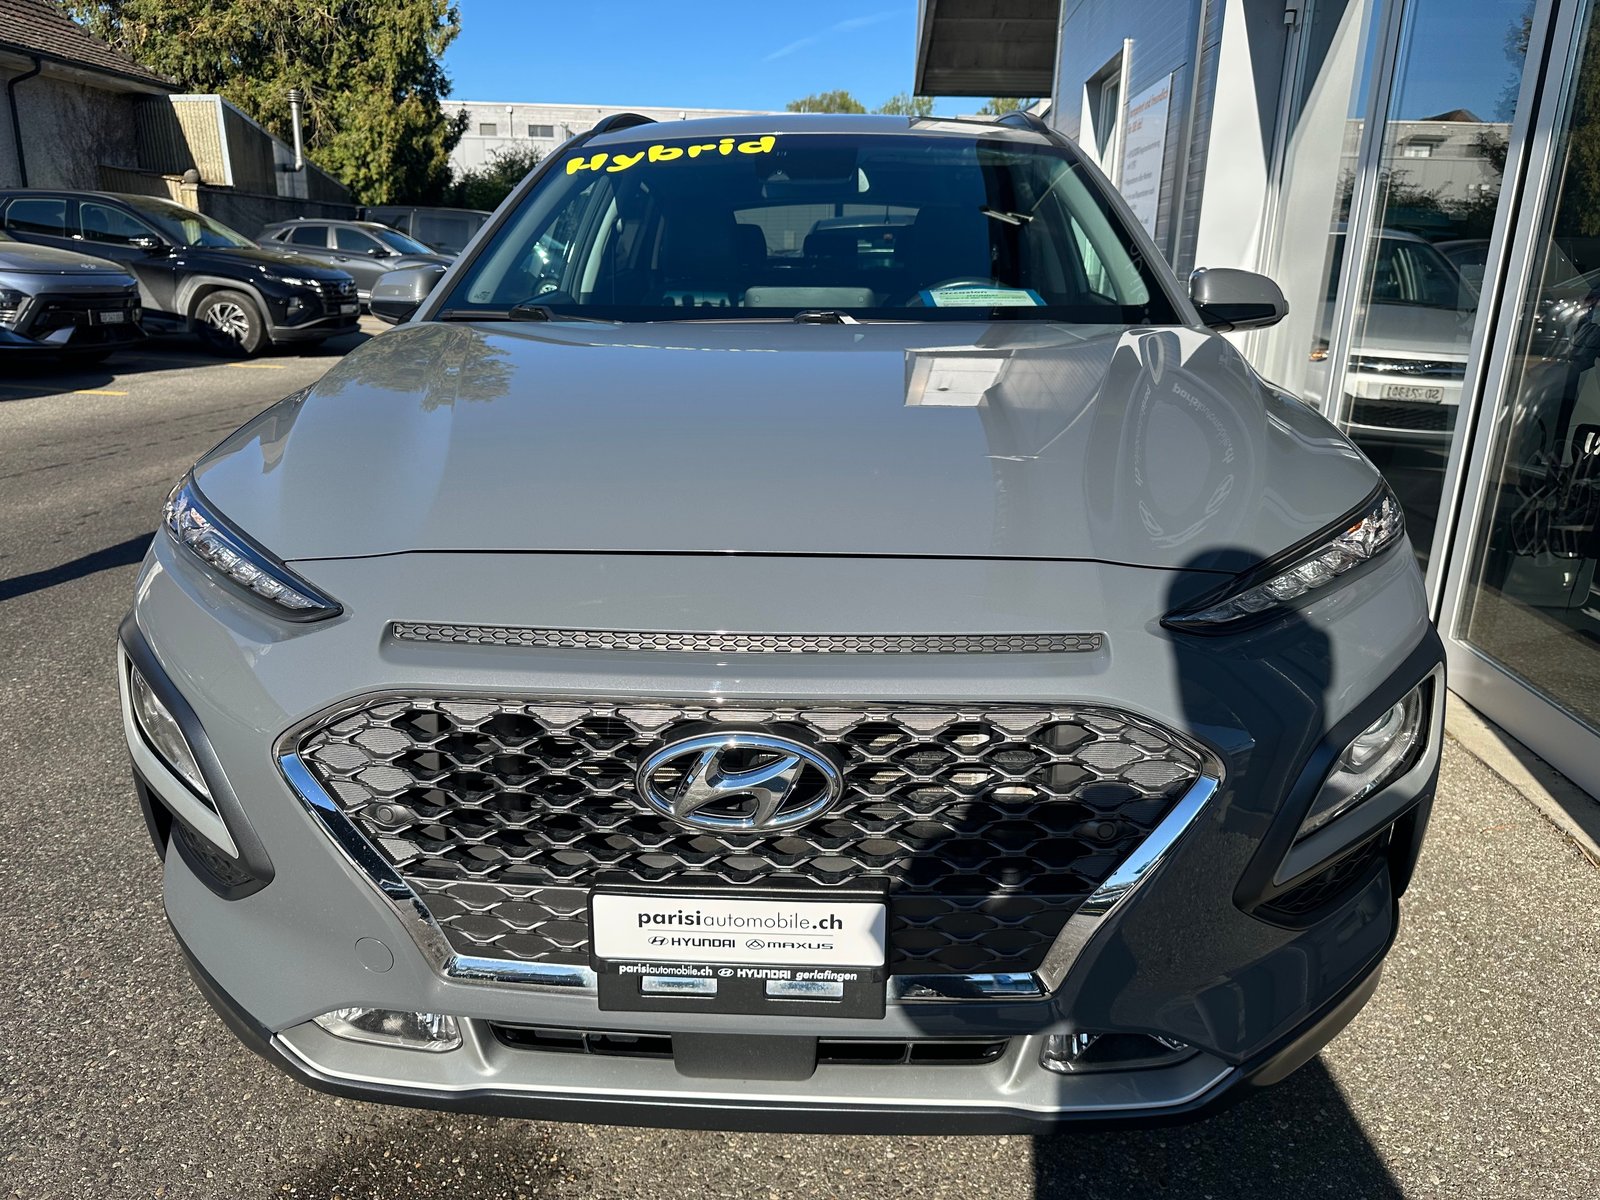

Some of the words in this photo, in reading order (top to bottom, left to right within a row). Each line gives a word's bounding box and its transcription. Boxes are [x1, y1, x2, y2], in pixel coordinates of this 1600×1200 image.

[566, 136, 776, 175] Hybrid
[638, 910, 842, 930] parisiautomobile.ch
[671, 937, 736, 948] HYUNDAI
[767, 942, 833, 950] MAXUS
[619, 964, 713, 978] parisiautomobile.ch
[736, 968, 791, 980] HYUNDAI
[795, 970, 857, 982] gerlafingen
